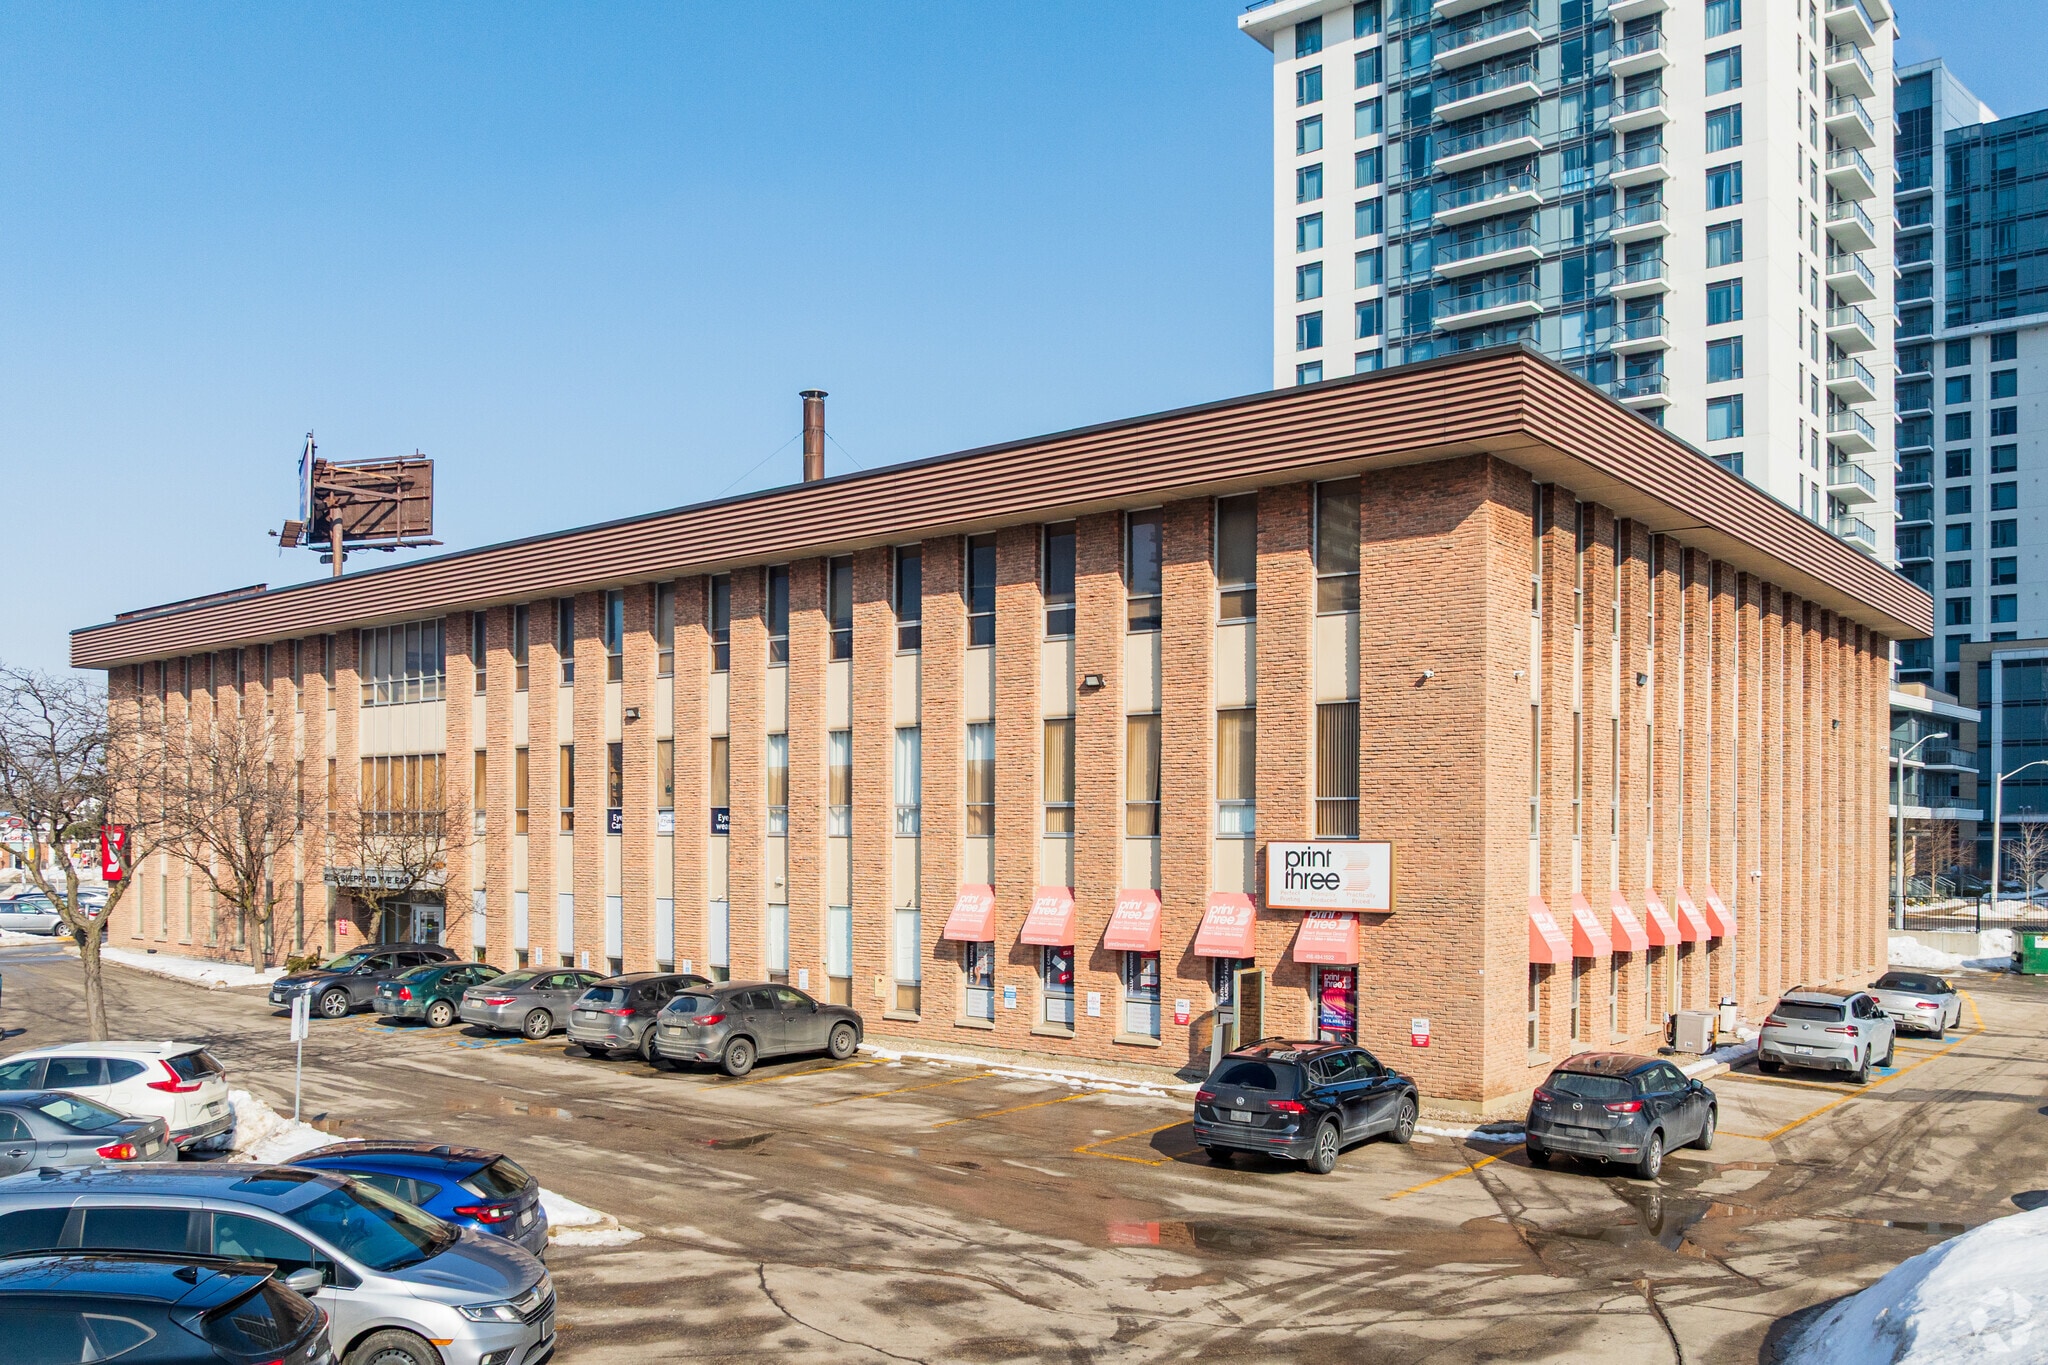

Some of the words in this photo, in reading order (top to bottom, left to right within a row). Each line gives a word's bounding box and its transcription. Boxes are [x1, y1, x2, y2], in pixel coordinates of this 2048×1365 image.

[1285, 846, 1332, 871] print
[1285, 868, 1340, 890] three
[1210, 903, 1236, 916] print
